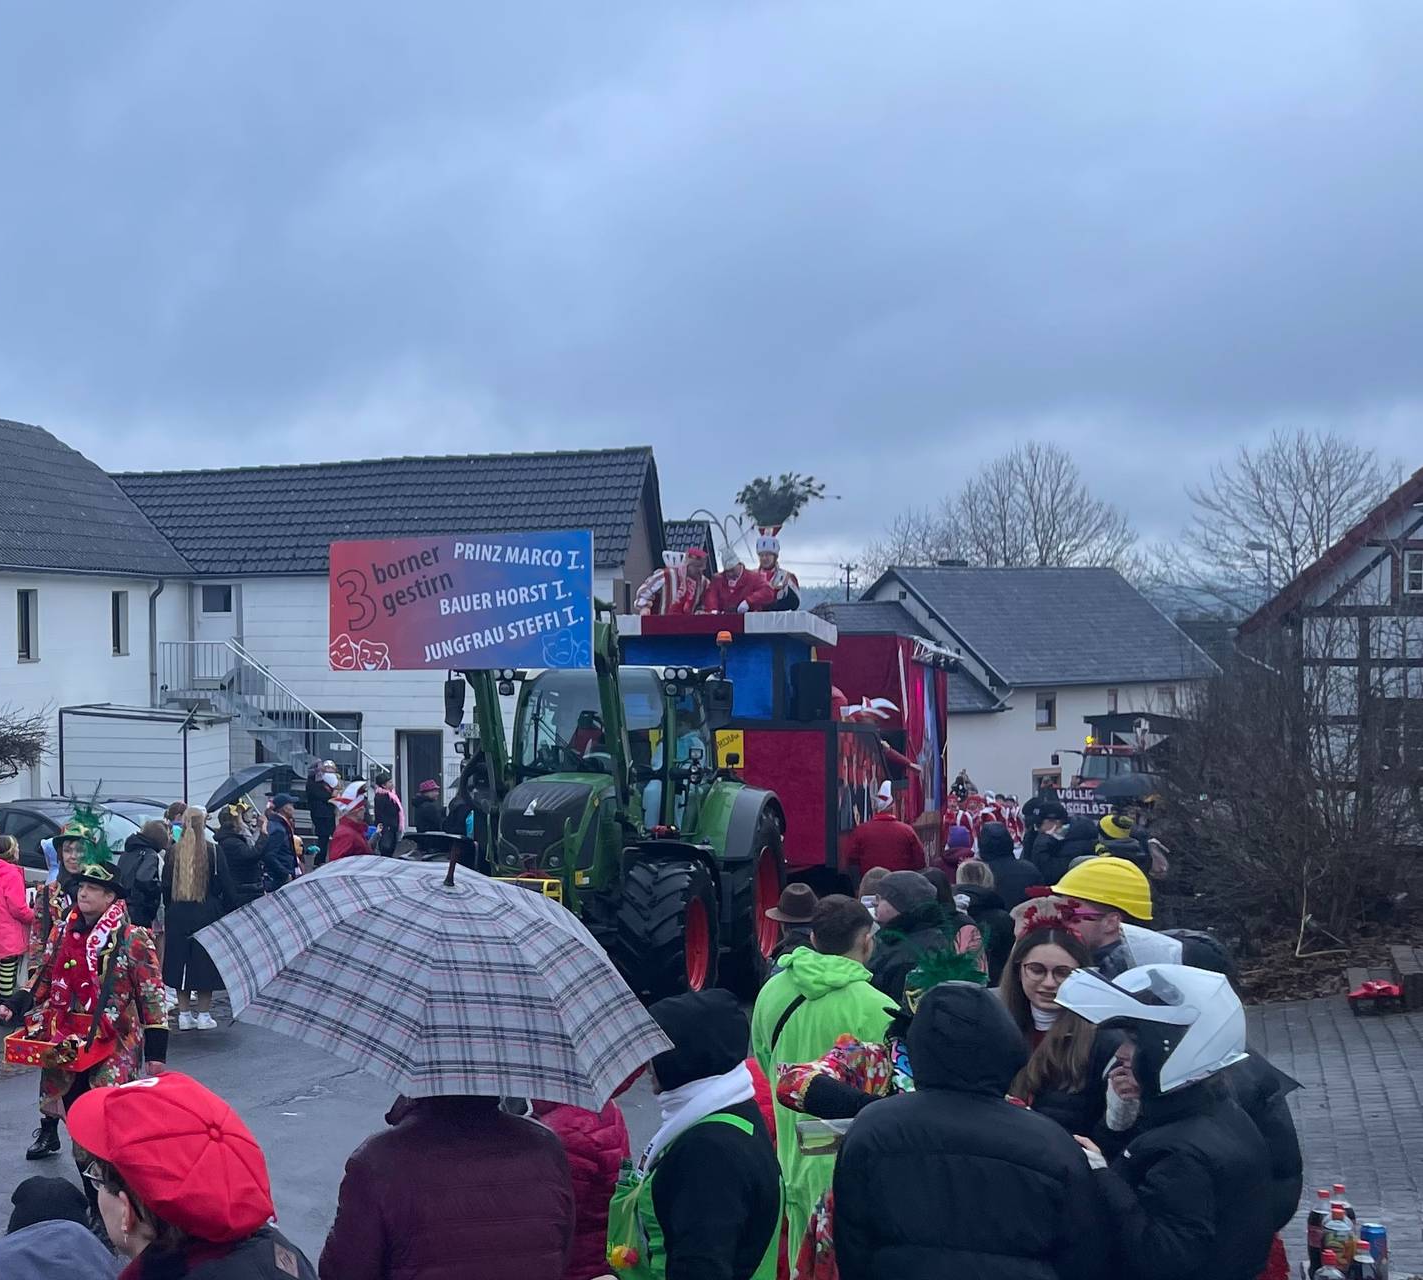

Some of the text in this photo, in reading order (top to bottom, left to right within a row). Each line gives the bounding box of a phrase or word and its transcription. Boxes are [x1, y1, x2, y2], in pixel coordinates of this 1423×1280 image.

[453, 542, 585, 571] PRINZ MARCO I.
[336, 545, 441, 632] 3 borner
[382, 571, 453, 617] gestirn
[440, 579, 573, 616] BAUER HORST I.
[424, 605, 585, 663] JUNGFRAU STEFFI I.
[1061, 802, 1114, 815] SGELÖST
